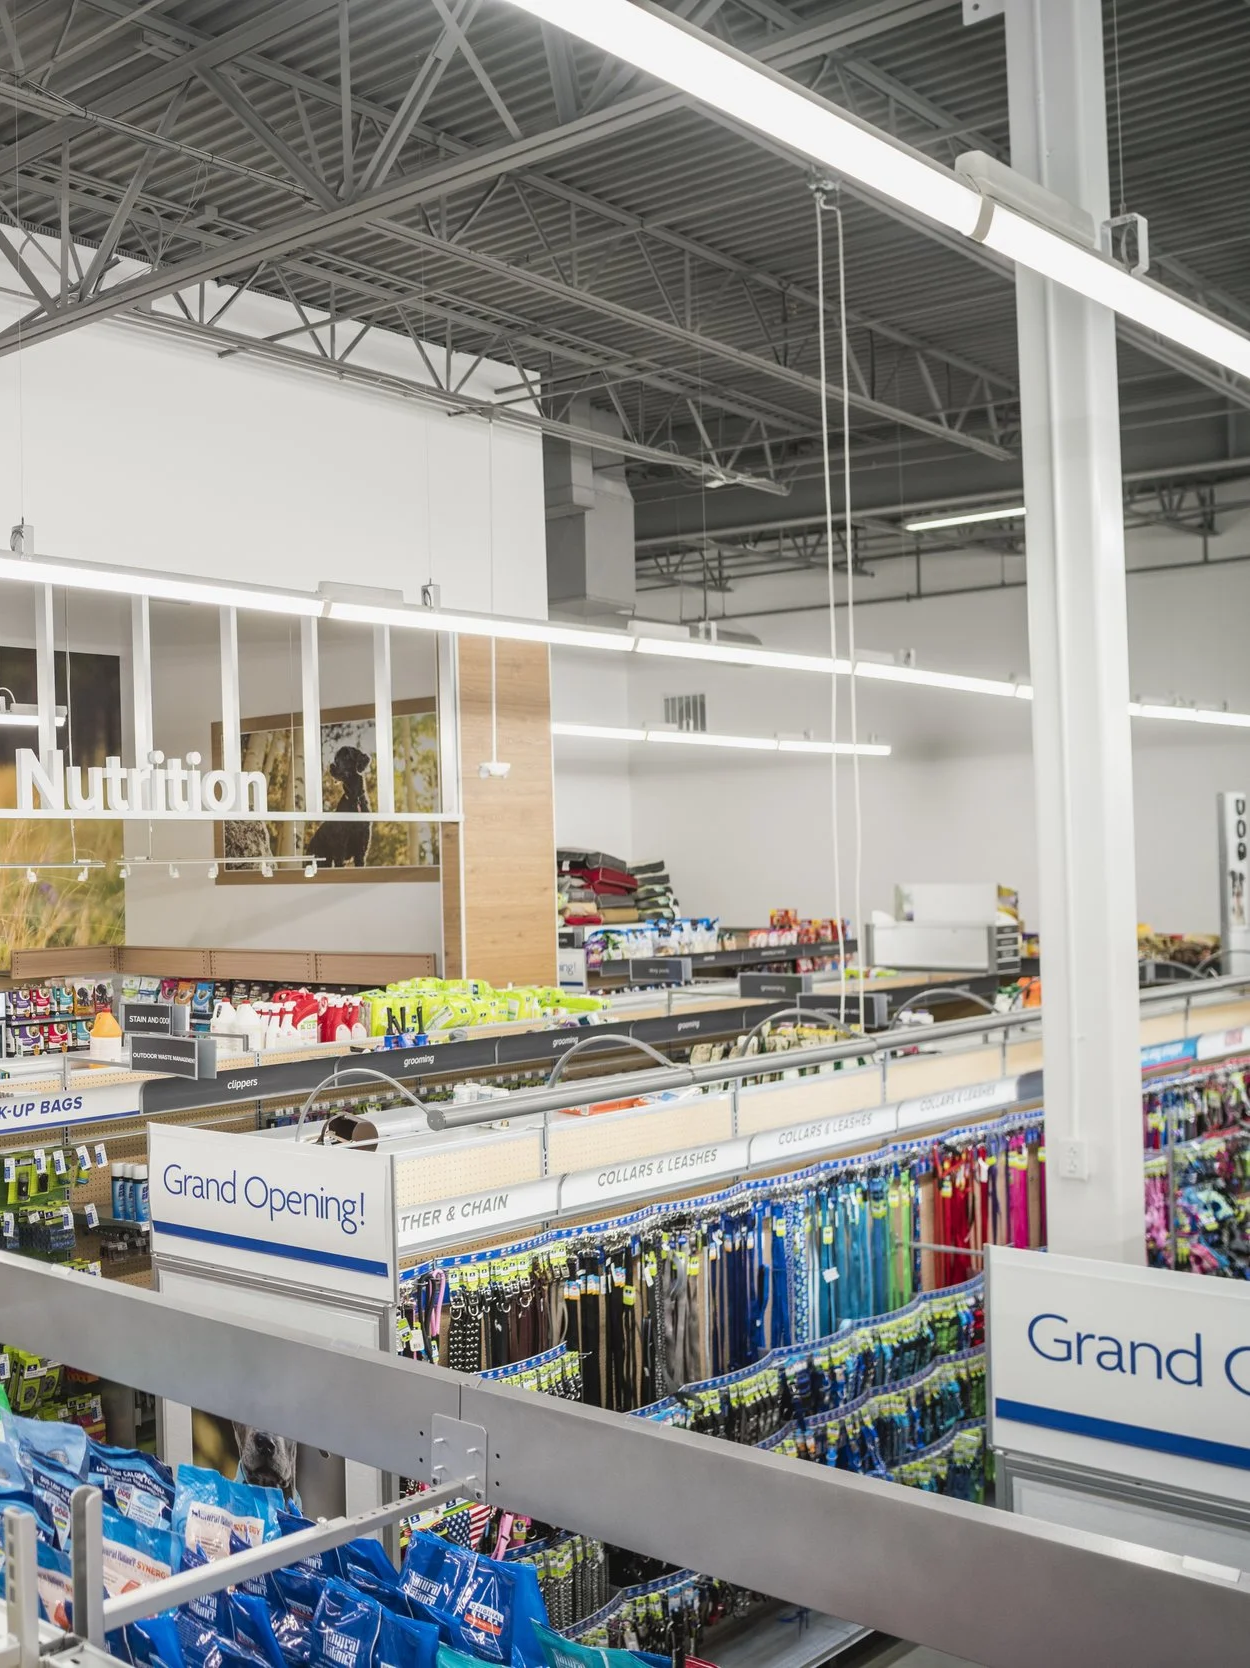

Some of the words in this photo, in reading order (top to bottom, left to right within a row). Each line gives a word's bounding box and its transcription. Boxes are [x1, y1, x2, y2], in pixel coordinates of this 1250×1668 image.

[16, 747, 268, 812] Nutrition
[129, 1015, 147, 1024] STAIN
[148, 1016, 159, 1024] AND
[553, 1036, 579, 1048] grooming
[132, 1052, 158, 1060] OUTDOOR
[158, 1053, 173, 1061] WASTE
[403, 1055, 435, 1067] grooming
[227, 1078, 258, 1090] clippers
[40, 1096, 83, 1115] BAGS
[778, 1123, 822, 1145] COLLARS
[833, 1112, 873, 1133] LEASHES
[598, 1163, 653, 1186] COLLARS
[657, 1160, 664, 1174] &
[667, 1149, 718, 1171] LEASHES
[163, 1164, 236, 1204] Grand
[244, 1176, 365, 1235] Opening!
[399, 1209, 442, 1231] THER
[446, 1206, 456, 1221] &
[461, 1194, 509, 1217] CHAIN
[1028, 1313, 1203, 1387] Grand
